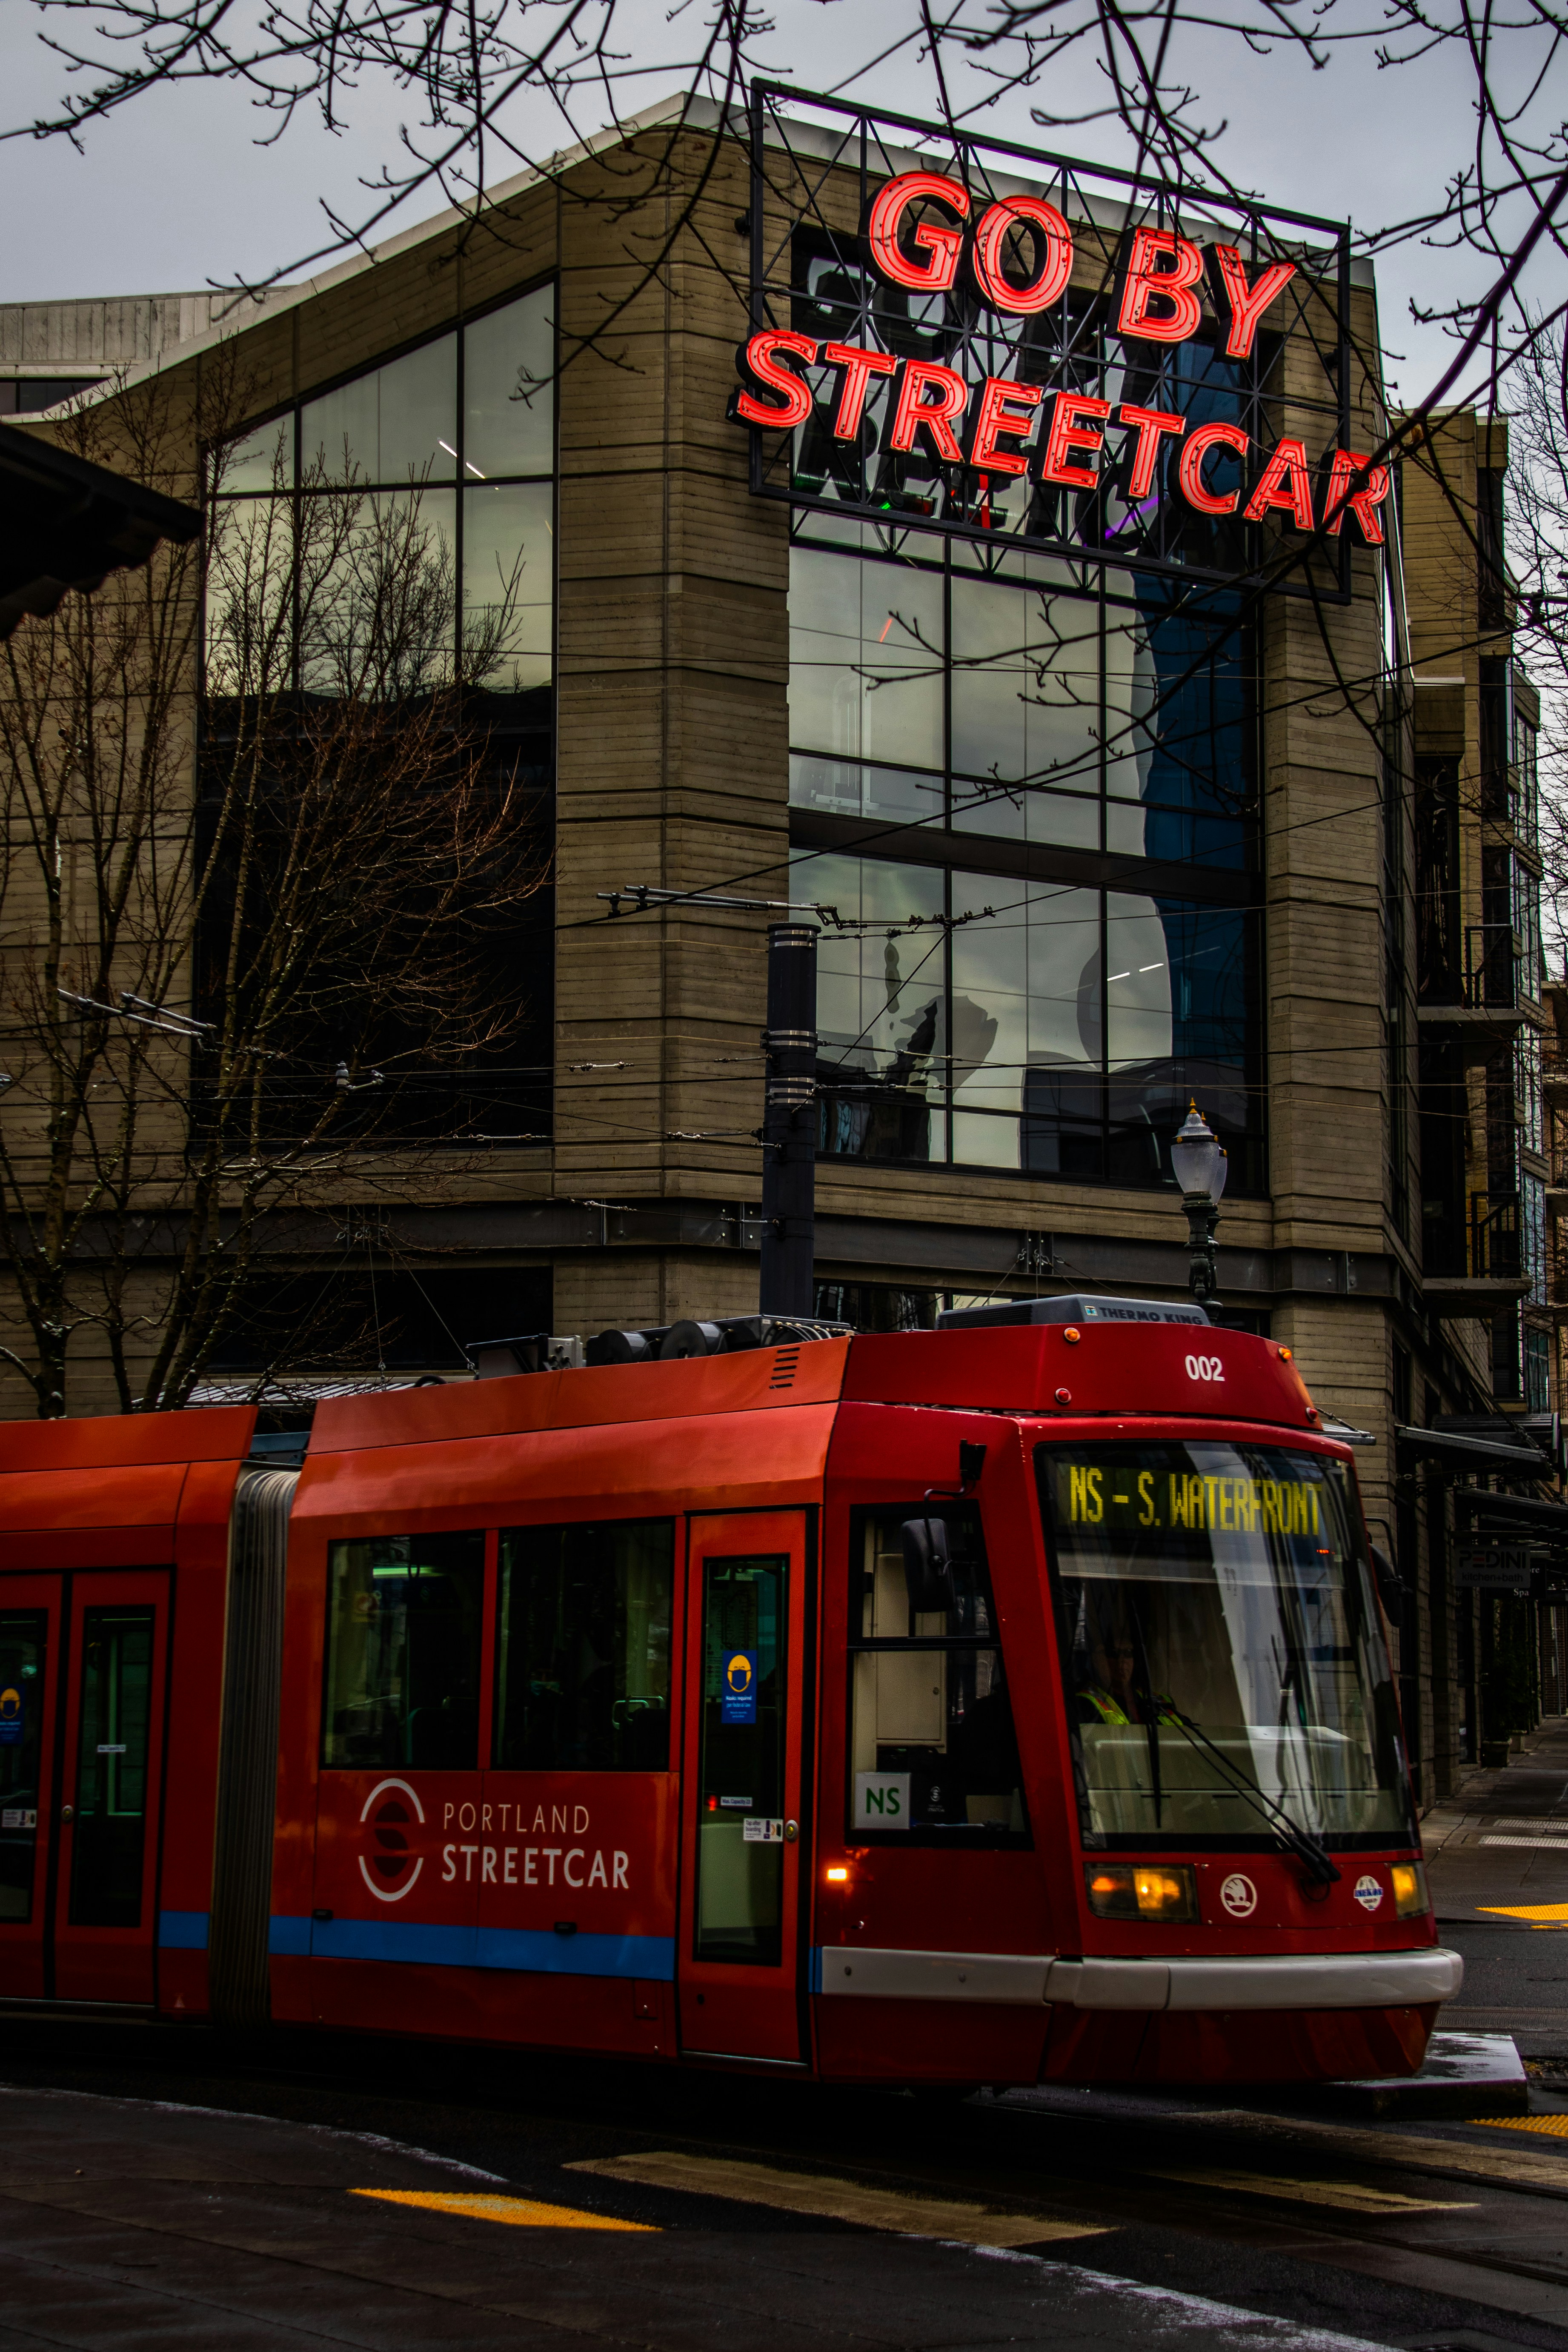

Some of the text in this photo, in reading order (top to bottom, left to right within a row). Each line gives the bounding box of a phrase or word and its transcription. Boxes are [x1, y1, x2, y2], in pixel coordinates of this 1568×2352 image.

[864, 171, 1296, 362] GO BY
[737, 330, 1391, 548] STREETCAR
[1099, 1307, 1160, 1322] THERMO
[1163, 1313, 1202, 1325] KING
[1185, 1355, 1225, 1382] 002
[1070, 1466, 1104, 1523] NS
[1138, 1471, 1161, 1527] S.
[1169, 1473, 1322, 1535] WATERFRONT
[1459, 1551, 1526, 1568] PEDINI
[1462, 1572, 1523, 1582] kitchen+bath
[1514, 1588, 1529, 1598] Spa
[866, 1787, 900, 1815] NS
[444, 1803, 589, 1834] PORTLAND
[442, 1844, 629, 1889] STREETCAR
